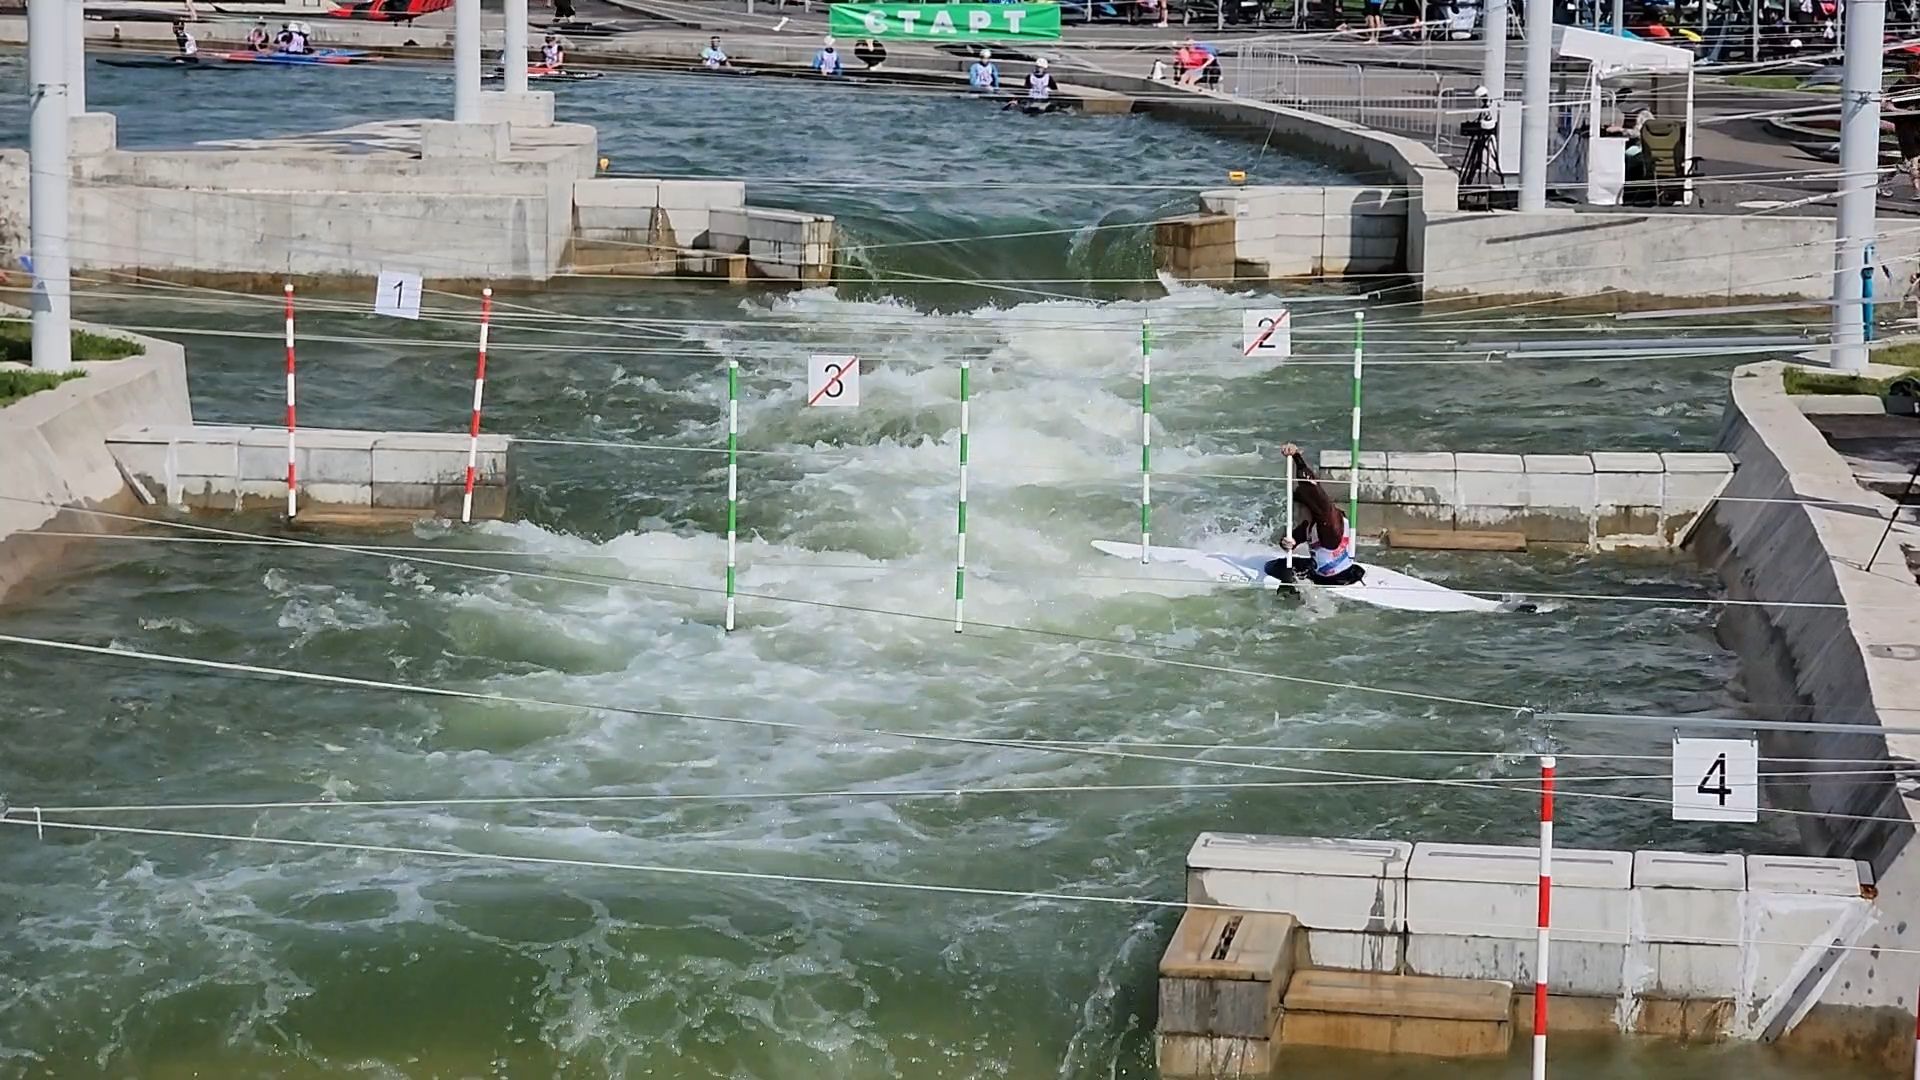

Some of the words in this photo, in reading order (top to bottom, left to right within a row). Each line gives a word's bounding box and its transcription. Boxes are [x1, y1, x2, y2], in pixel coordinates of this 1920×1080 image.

[864, 9, 1027, 34] СТАРТ
[393, 279, 404, 310] 1
[1258, 317, 1276, 348] 2
[824, 363, 844, 398] 3
[1697, 752, 1732, 806] 4
